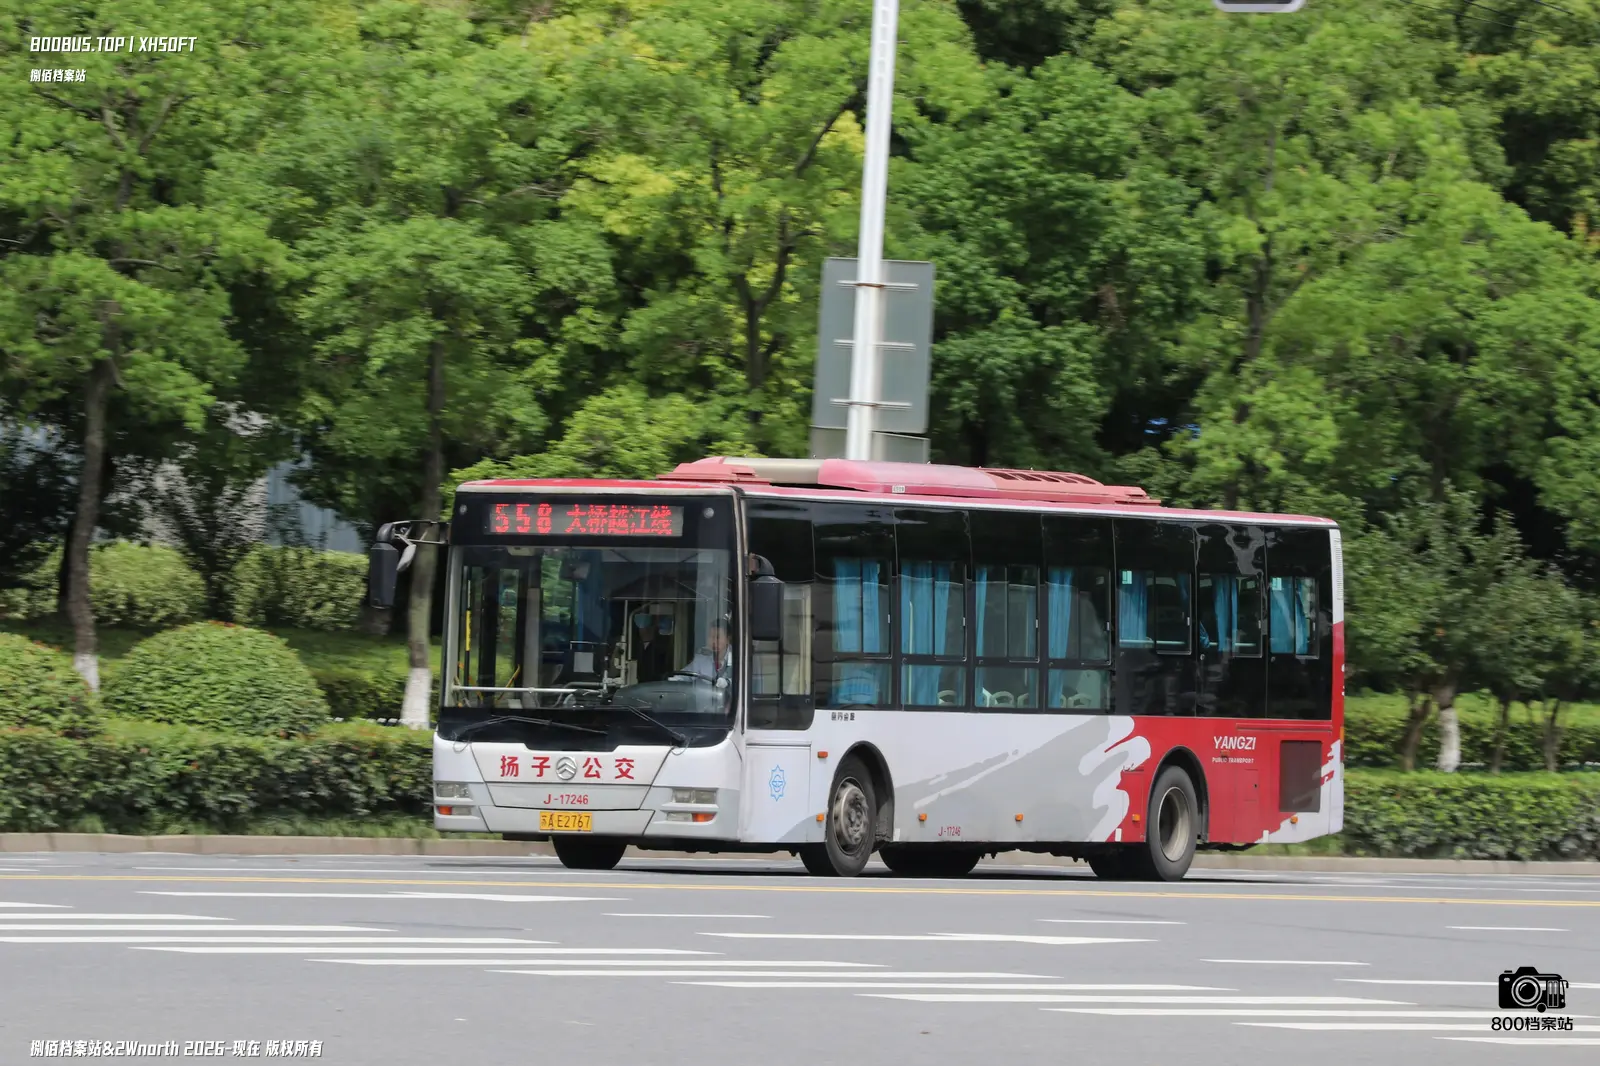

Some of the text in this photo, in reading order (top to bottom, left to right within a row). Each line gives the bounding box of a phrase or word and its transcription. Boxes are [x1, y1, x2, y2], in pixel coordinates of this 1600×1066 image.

[495, 503, 552, 534] 558
[1213, 735, 1257, 750] YANGZI
[1212, 756, 1227, 764] PUBLIC
[543, 793, 589, 805] J-17246
[938, 826, 961, 837] J-17246
